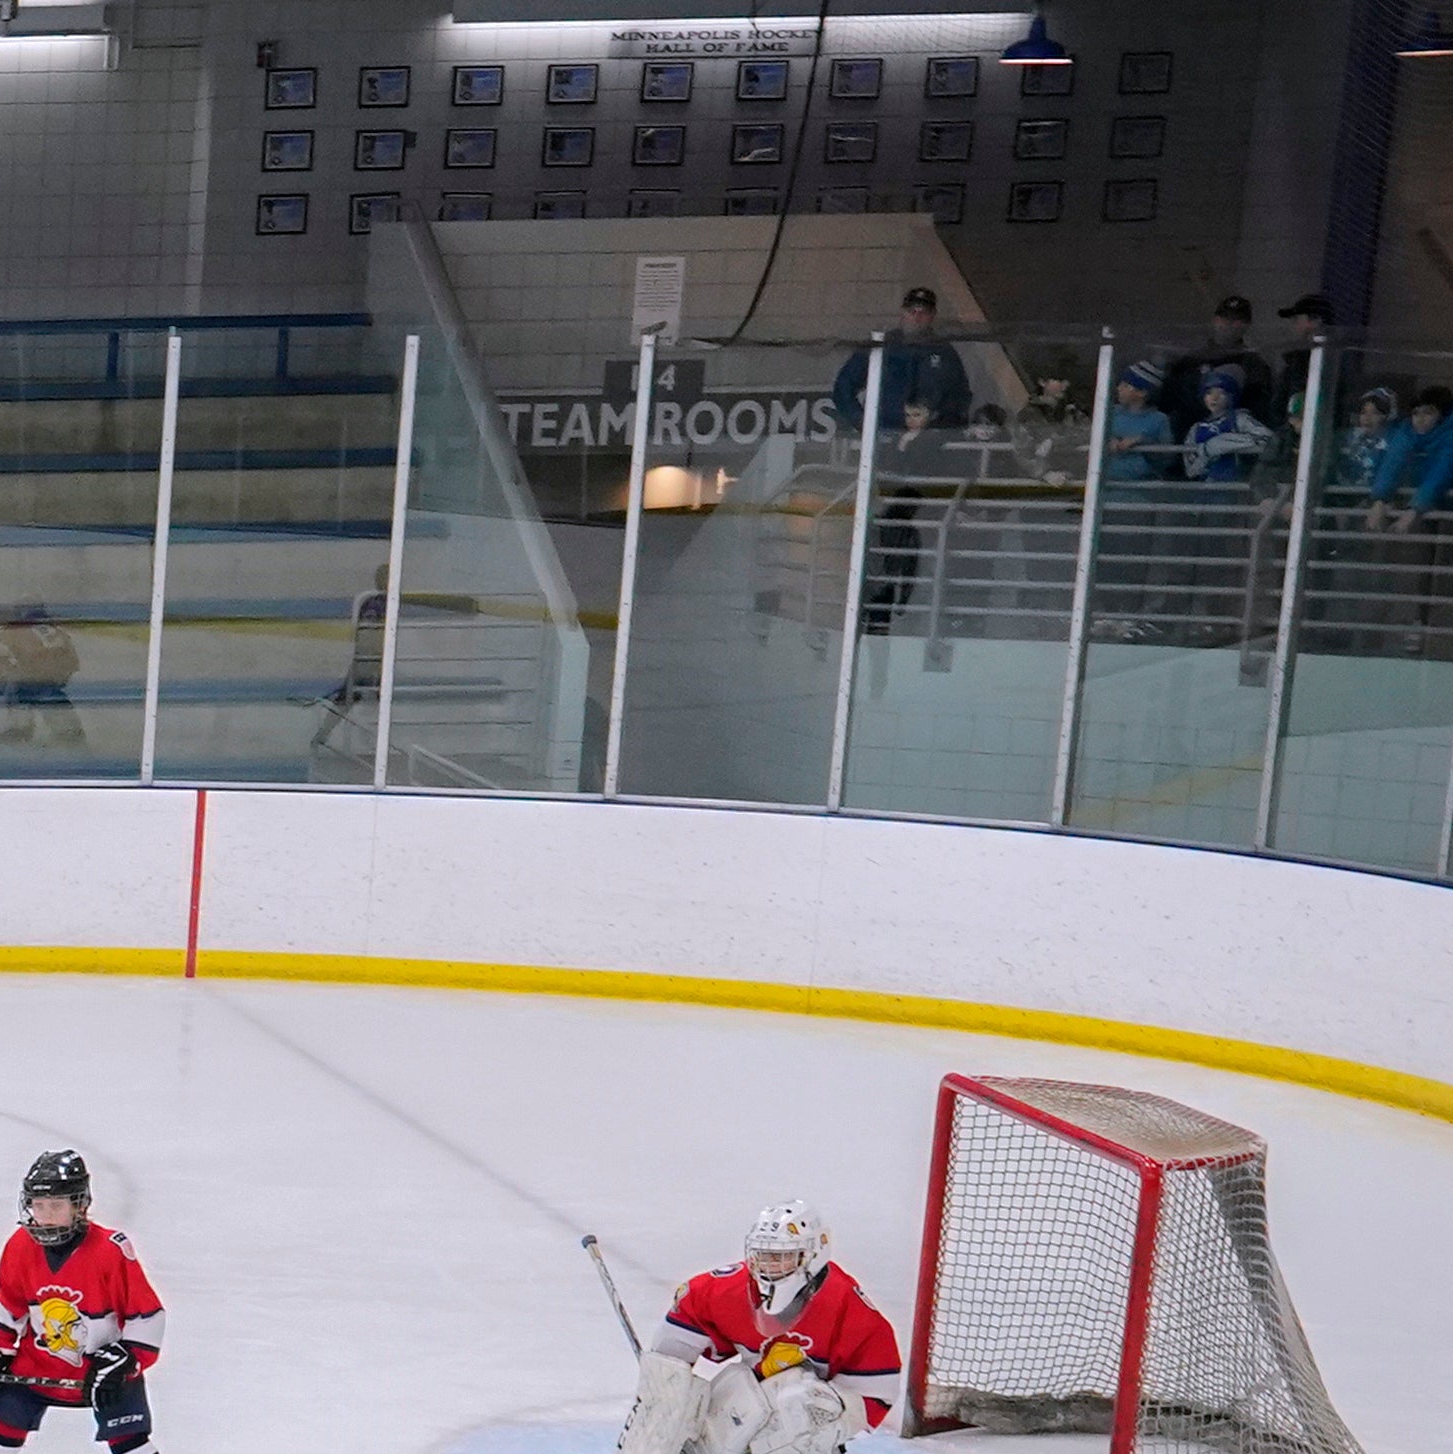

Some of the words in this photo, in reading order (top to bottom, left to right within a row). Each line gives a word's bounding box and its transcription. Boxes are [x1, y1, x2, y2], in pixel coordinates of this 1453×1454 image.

[611, 30, 740, 41] MINNEAPOLIS
[748, 29, 820, 40] HOCKEY
[646, 43, 693, 53] HALL
[703, 42, 729, 53] OF
[736, 41, 790, 52] FAME
[500, 402, 637, 447] TEAM
[653, 399, 837, 445] ROOMS
[107, 1414, 143, 1428] CCM
